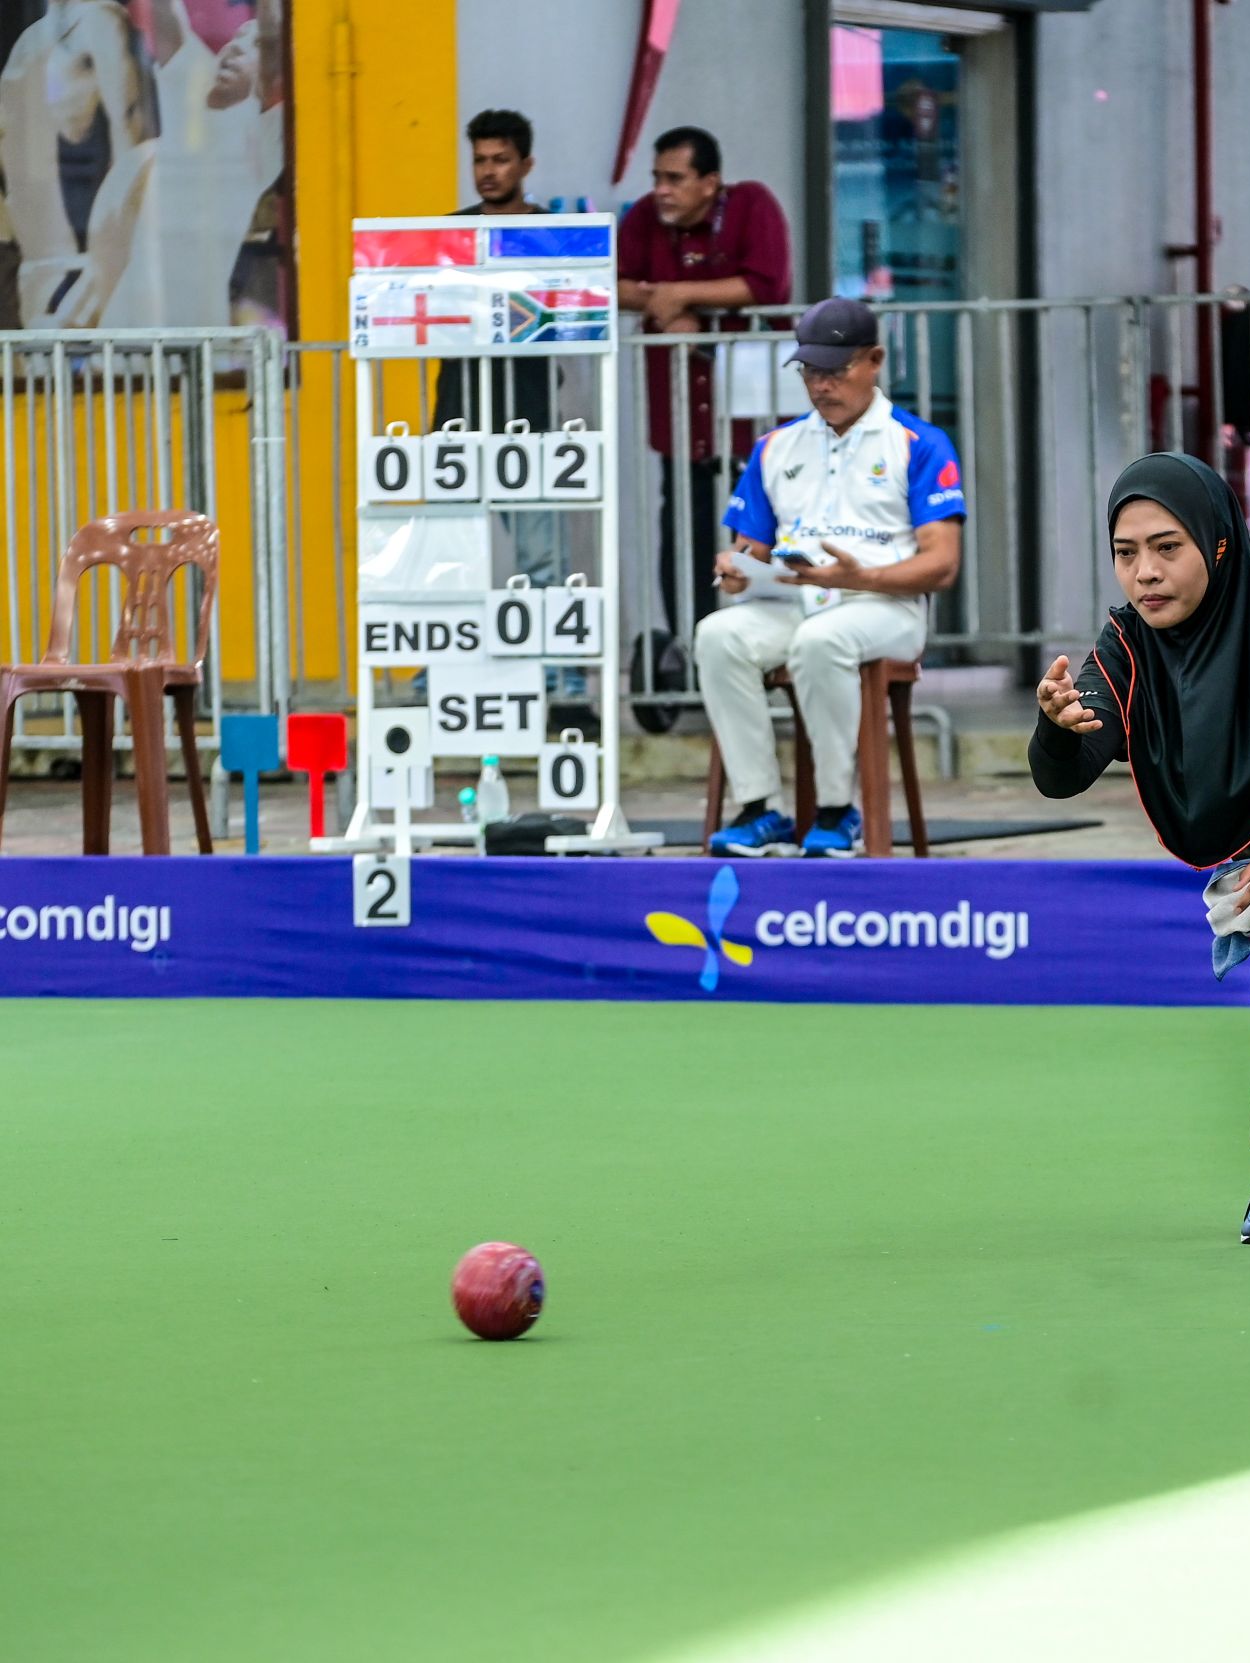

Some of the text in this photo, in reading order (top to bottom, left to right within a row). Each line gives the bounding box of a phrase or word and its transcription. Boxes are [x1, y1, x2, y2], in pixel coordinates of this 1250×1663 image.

[365, 600, 590, 653] ENDS 04
[439, 693, 539, 732] SET
[552, 754, 584, 798] 0
[366, 869, 399, 919] 2
[0, 894, 171, 953] omdigi
[755, 900, 1029, 960] celcomdigi
